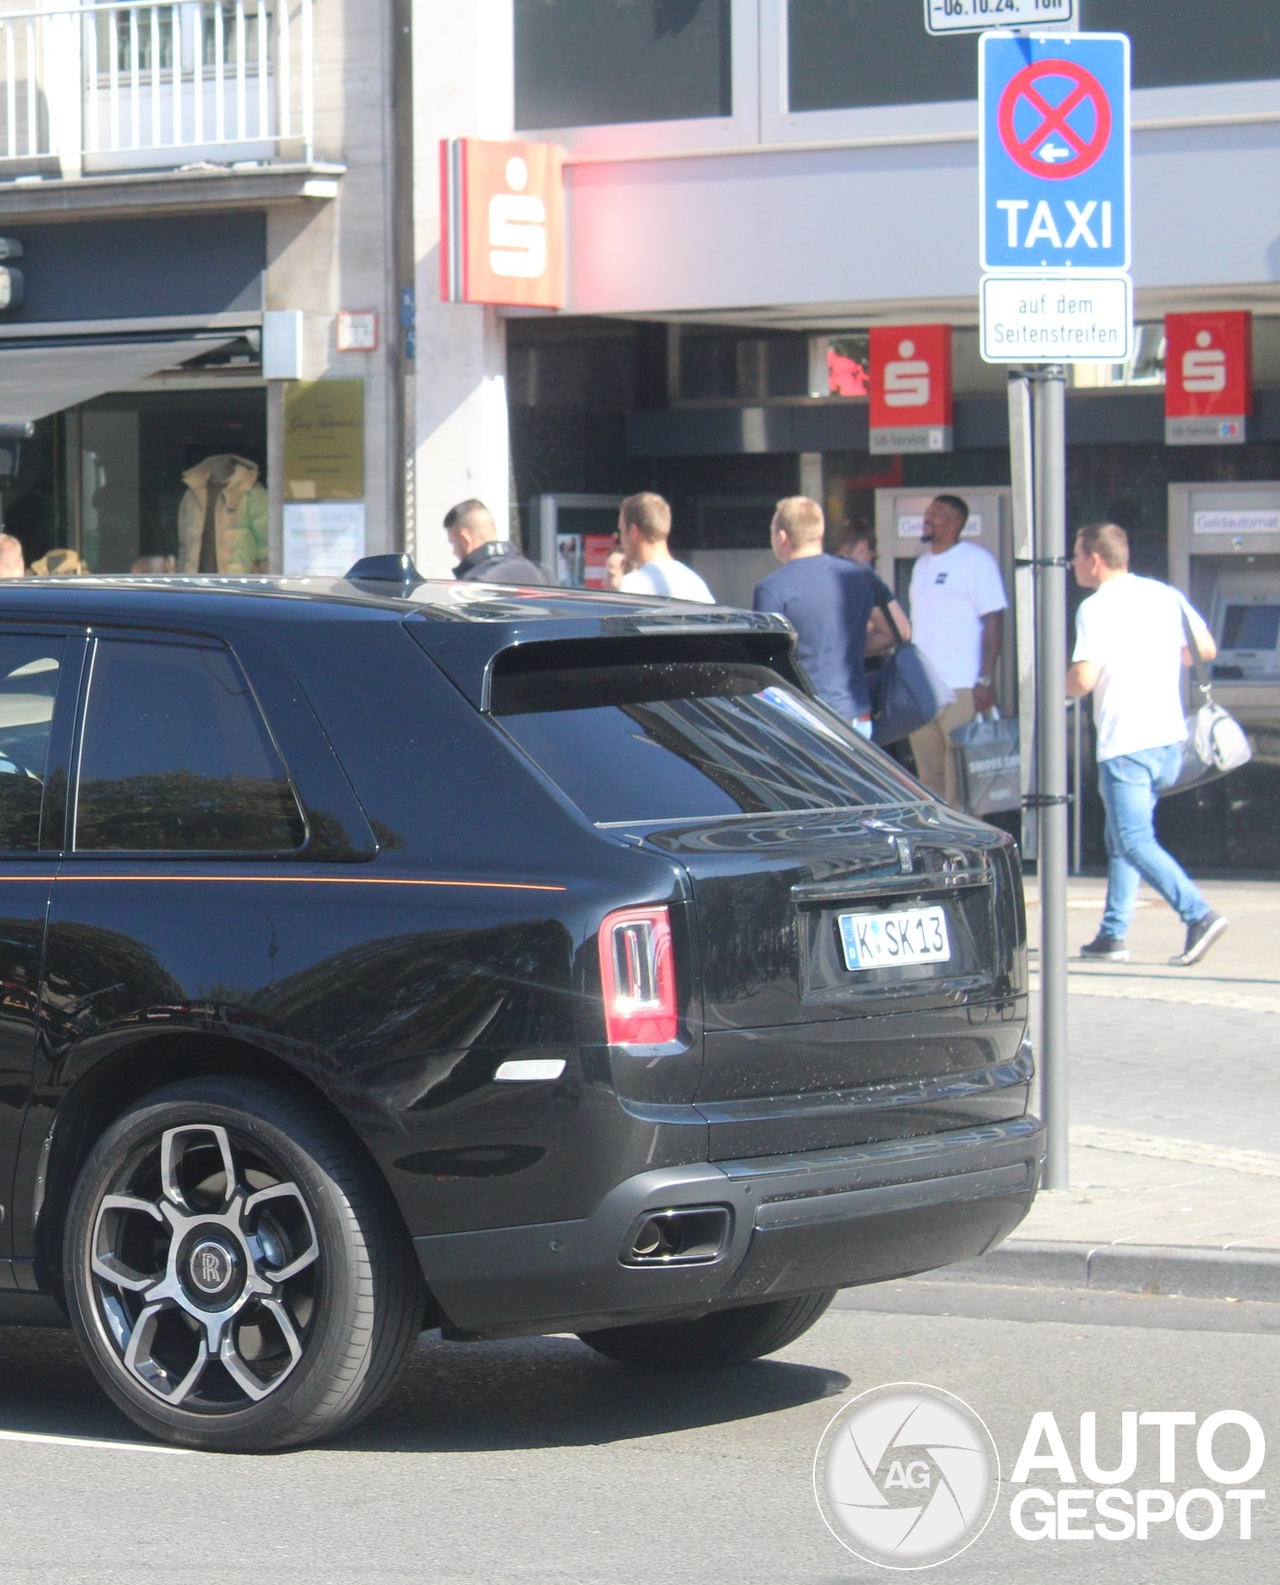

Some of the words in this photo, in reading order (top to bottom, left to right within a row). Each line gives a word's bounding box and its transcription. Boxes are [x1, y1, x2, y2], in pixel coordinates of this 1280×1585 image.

[996, 200, 1112, 249] TAXI
[1018, 294, 1046, 314] auf
[1057, 294, 1093, 314] dem
[994, 323, 1118, 343] Seitenstreifen
[1197, 514, 1278, 529] Geldautomat
[856, 922, 873, 960] K
